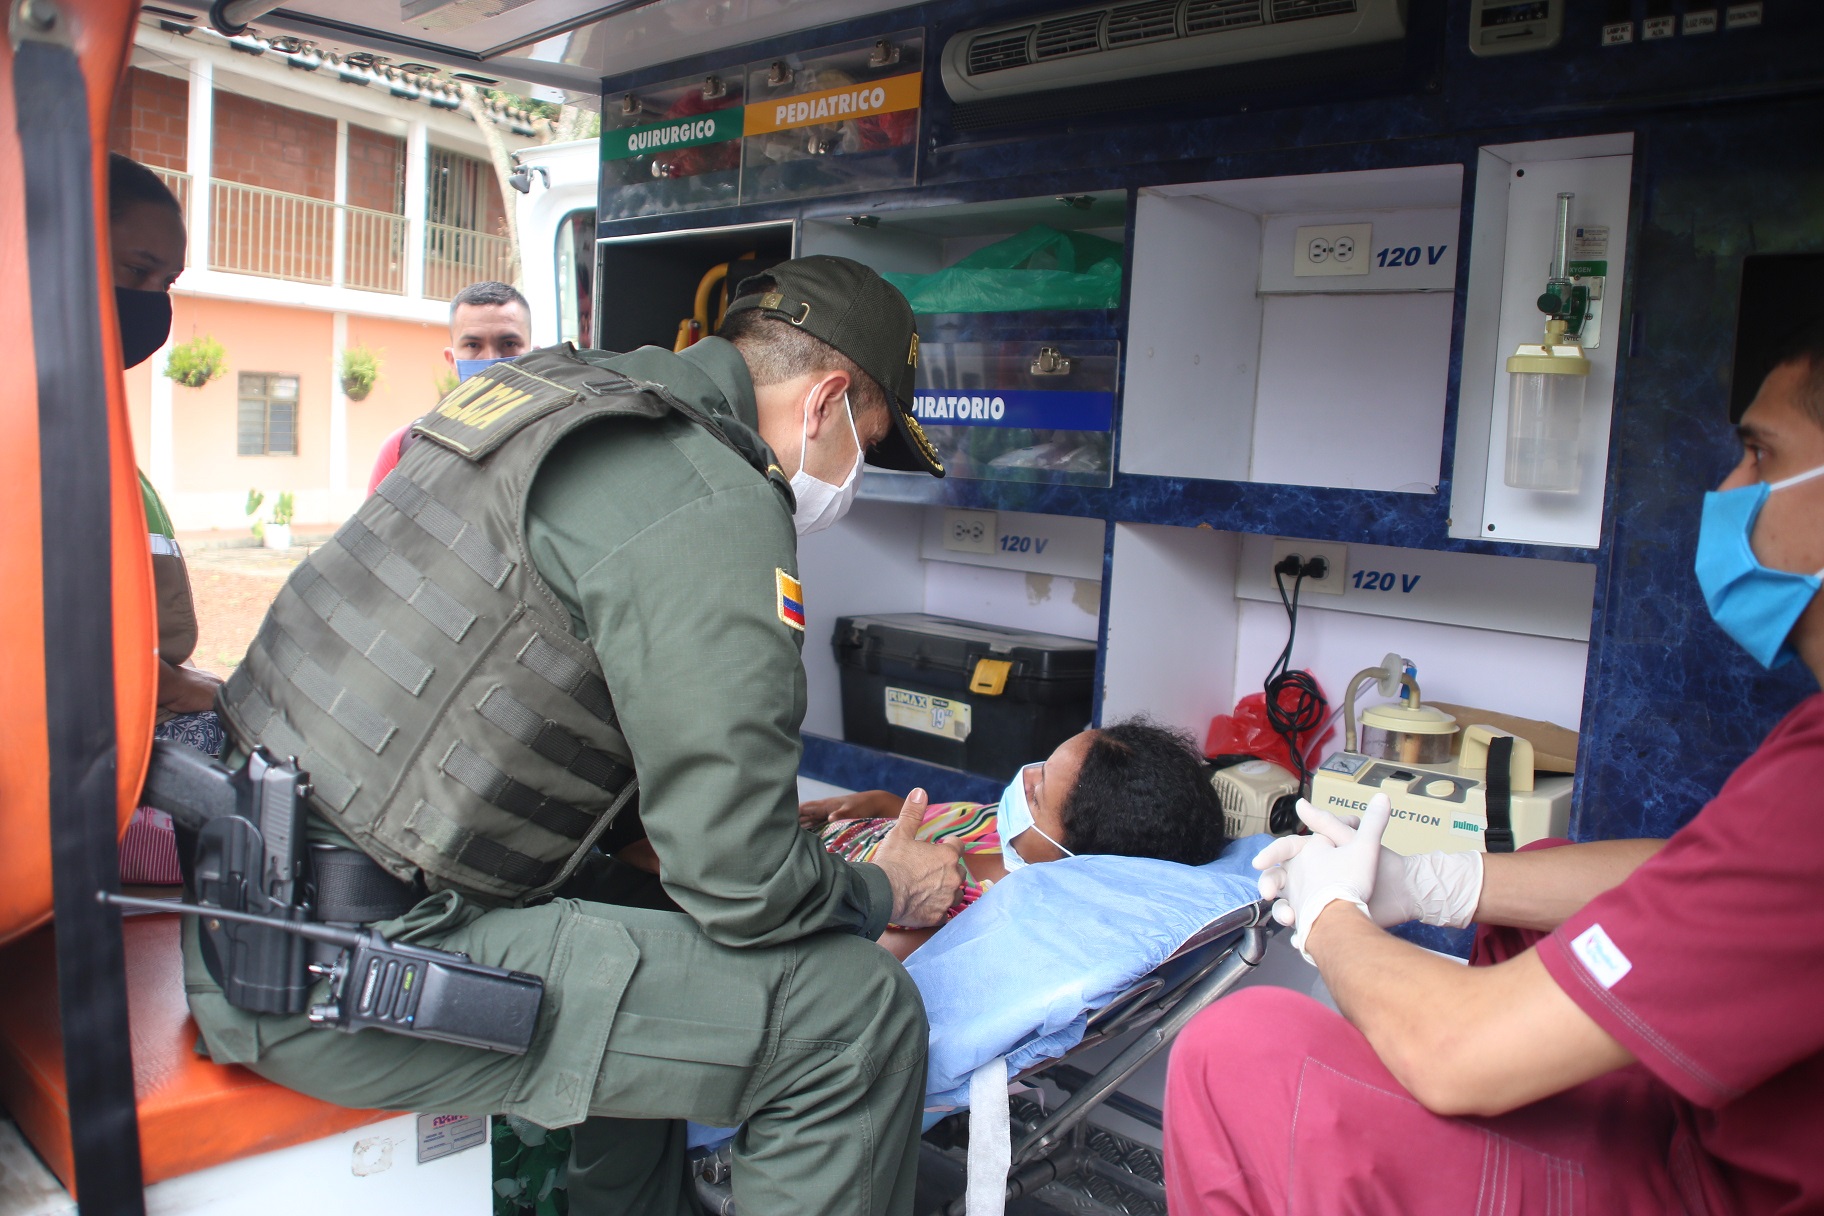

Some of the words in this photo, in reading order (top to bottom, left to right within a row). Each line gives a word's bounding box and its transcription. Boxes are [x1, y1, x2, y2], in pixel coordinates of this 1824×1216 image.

[775, 86, 886, 126] PEDIATRICO
[627, 118, 716, 151] QUIRURGICO
[1376, 246, 1422, 268] 120
[1427, 244, 1448, 266] V
[1000, 534, 1031, 553] 120
[1035, 537, 1049, 554] V
[1352, 569, 1397, 592] 120
[1402, 573, 1421, 593] V
[888, 689, 928, 709] RIMAX
